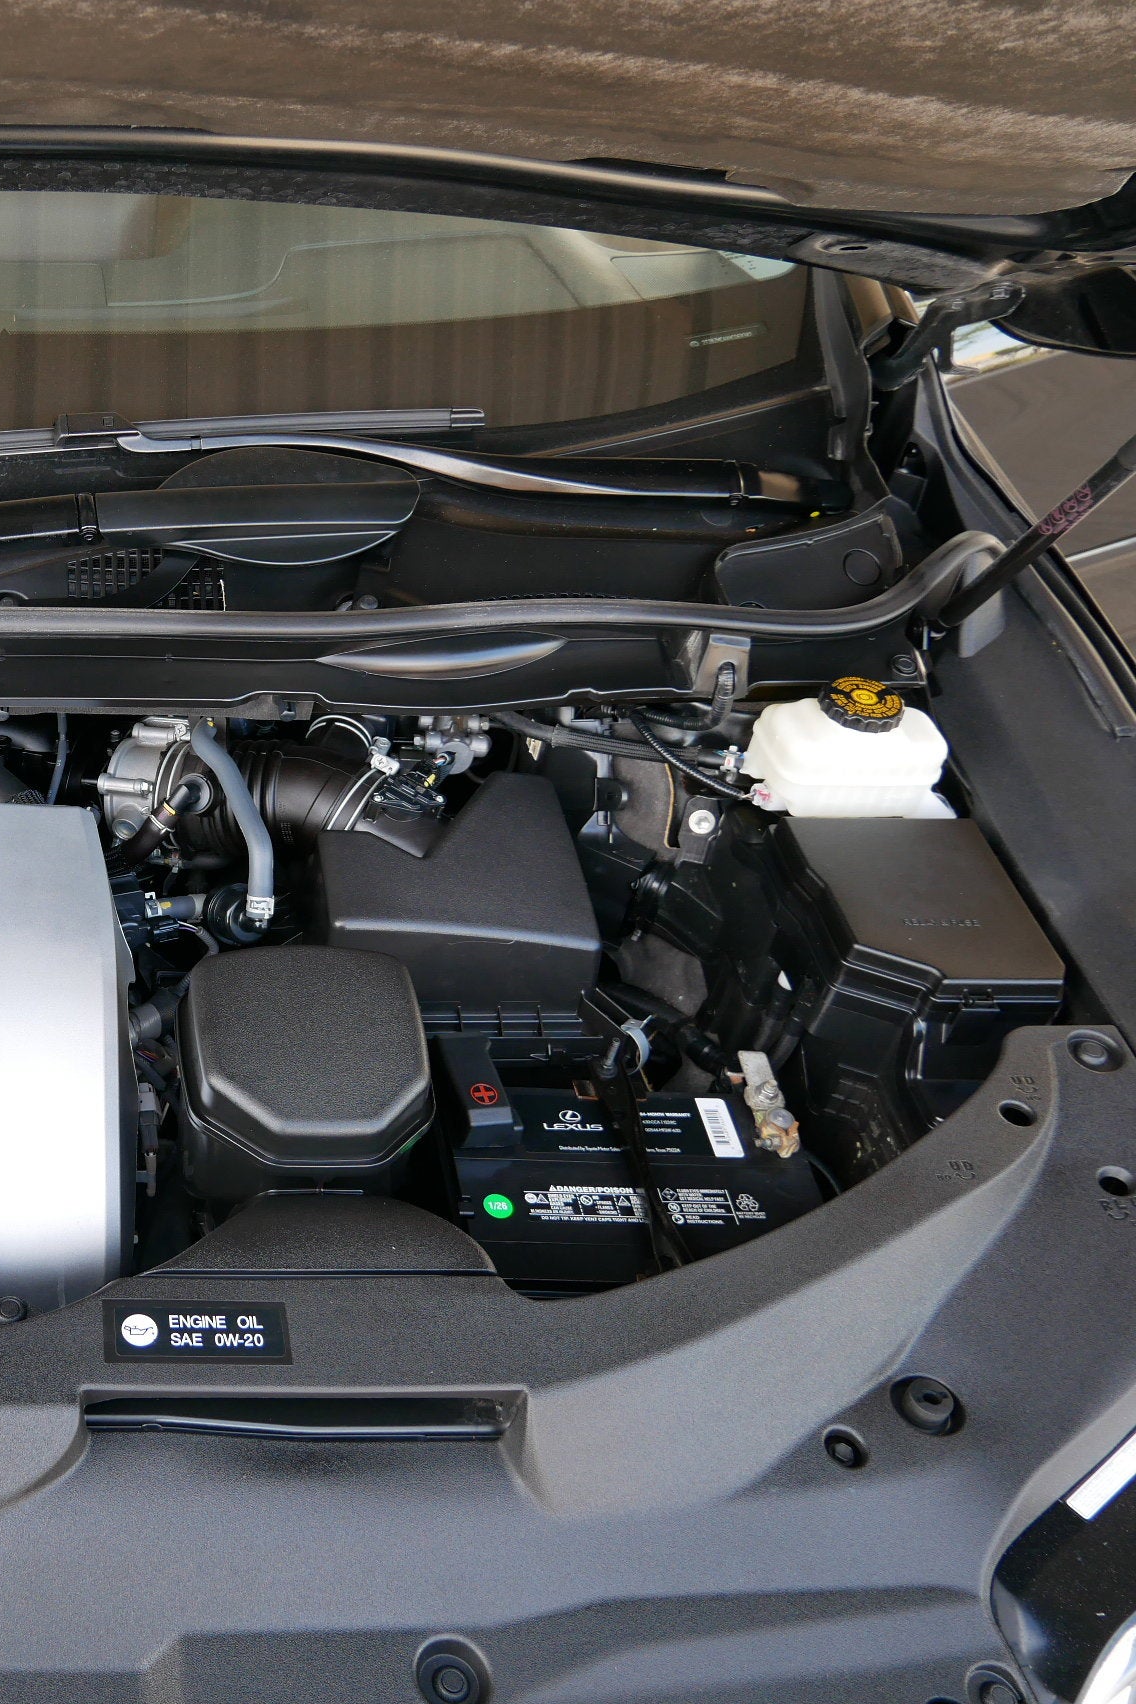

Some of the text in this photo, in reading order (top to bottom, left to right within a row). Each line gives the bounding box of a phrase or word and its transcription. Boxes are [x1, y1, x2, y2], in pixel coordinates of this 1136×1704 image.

[542, 1122, 604, 1131] LEXUS
[556, 1185, 634, 1194] DANGER/POISON
[488, 1201, 508, 1211] 1/26
[168, 1314, 264, 1330] ENGINE OIL
[170, 1332, 264, 1348] SAE 0W-20
